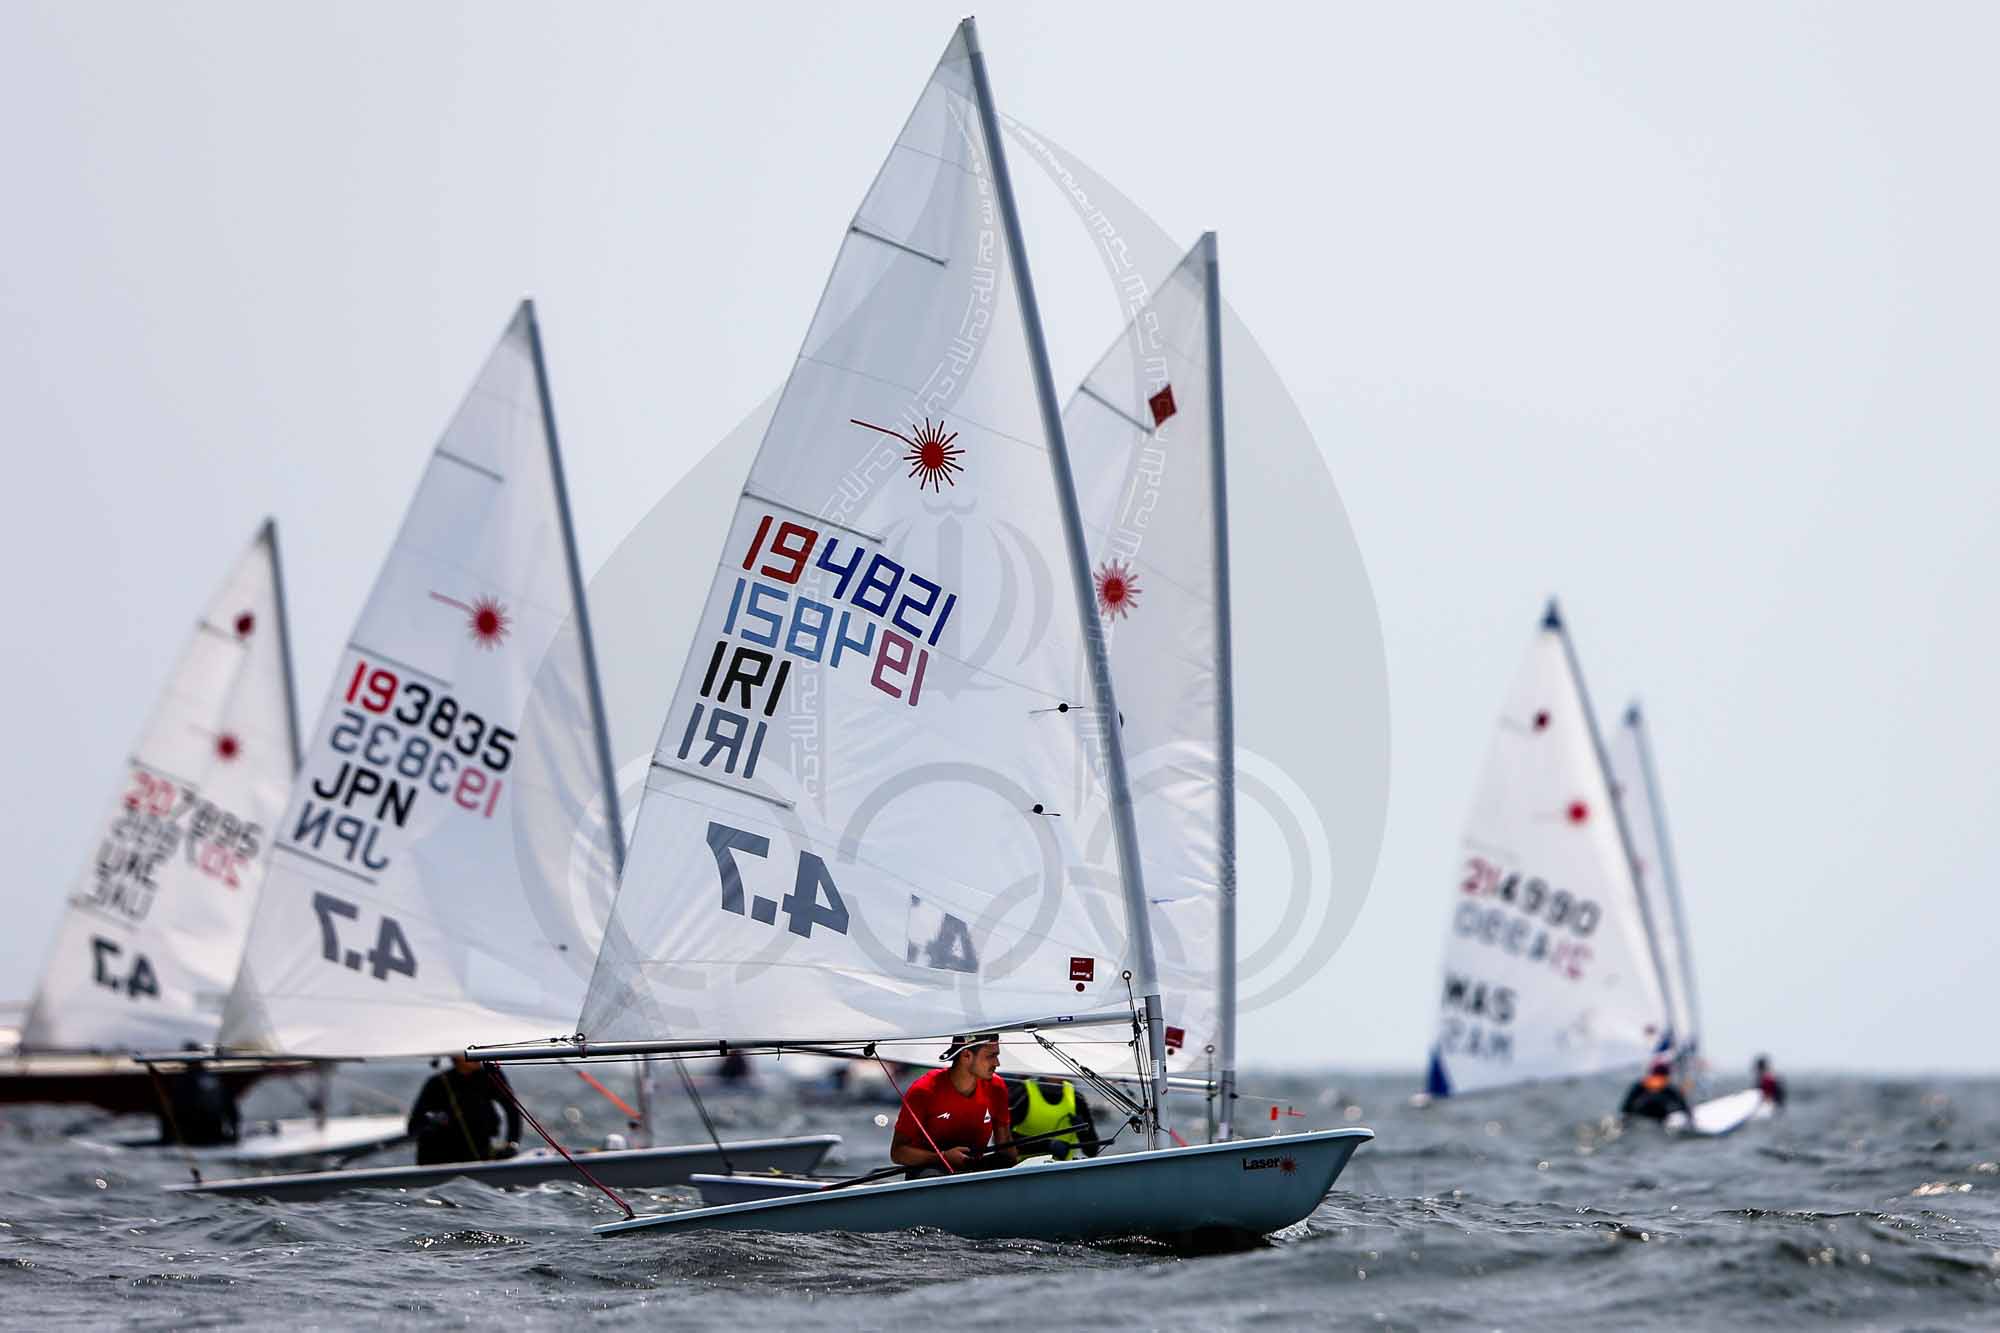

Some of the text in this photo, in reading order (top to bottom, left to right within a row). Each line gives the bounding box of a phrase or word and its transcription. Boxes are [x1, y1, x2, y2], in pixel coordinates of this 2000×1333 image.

[742, 515, 957, 647] 194821
[345, 660, 517, 772] 193835
[700, 640, 792, 717] IRI
[312, 762, 417, 828] JPN
[1242, 1158, 1281, 1171] Laser
